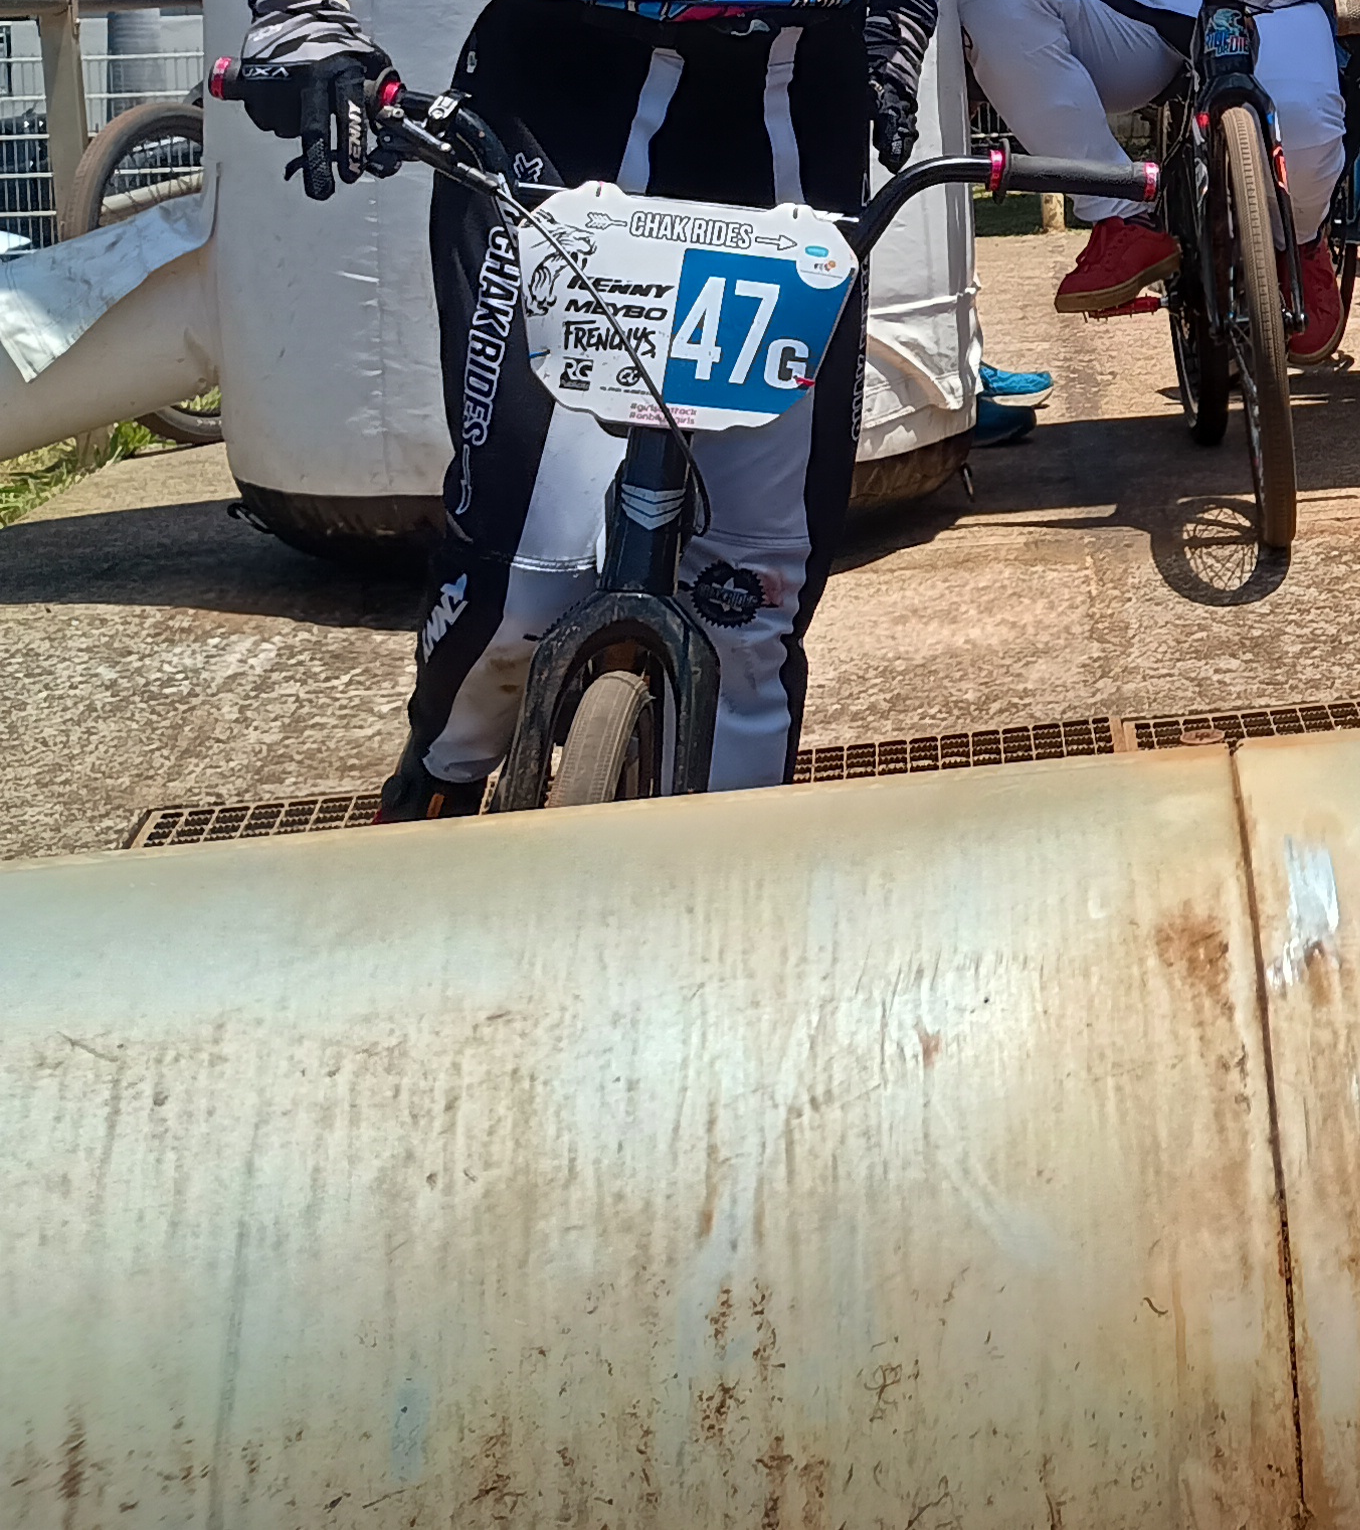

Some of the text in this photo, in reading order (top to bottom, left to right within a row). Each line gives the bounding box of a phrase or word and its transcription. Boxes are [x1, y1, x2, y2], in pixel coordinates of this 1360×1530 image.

[629, 210, 754, 250] CHAK RIDES
[467, 223, 521, 338] CHAK
[565, 274, 675, 300] KENNY
[563, 298, 669, 322] MEYBO
[670, 275, 810, 391] 47G
[562, 357, 595, 382] RC
[462, 328, 507, 448] RIDES
[629, 402, 698, 417] #girlstrack
